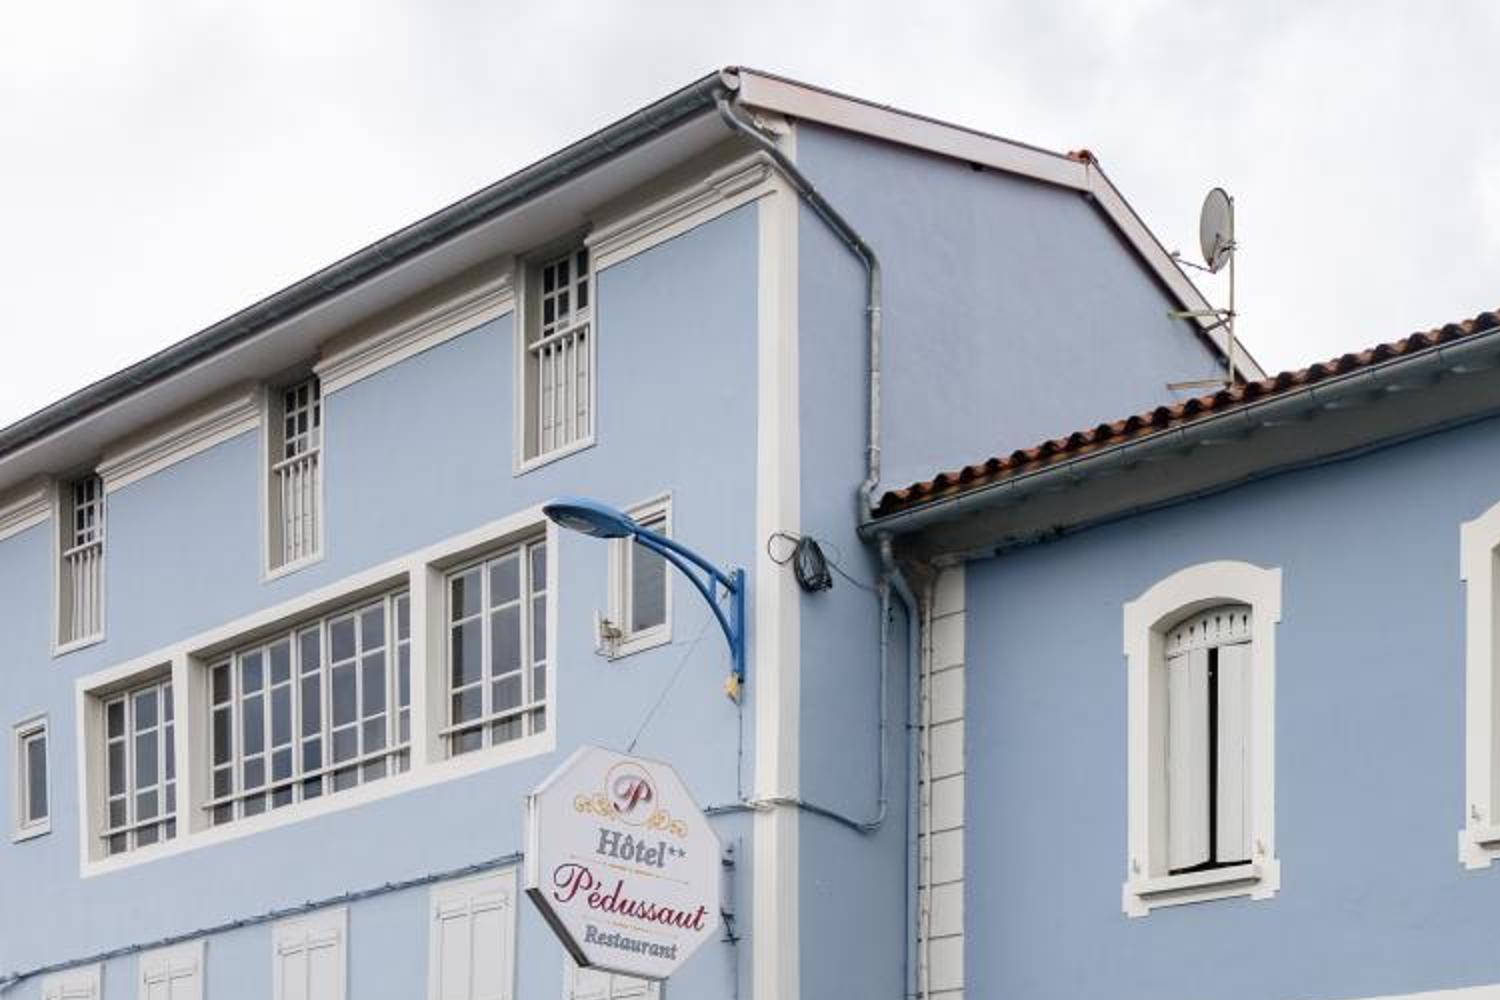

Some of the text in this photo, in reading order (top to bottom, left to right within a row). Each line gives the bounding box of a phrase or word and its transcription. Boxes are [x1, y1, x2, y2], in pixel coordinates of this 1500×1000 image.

[613, 774, 653, 814] P
[596, 829, 665, 868] Hôtel
[553, 863, 709, 931] Pédussaut
[584, 924, 678, 960] Restaurant
